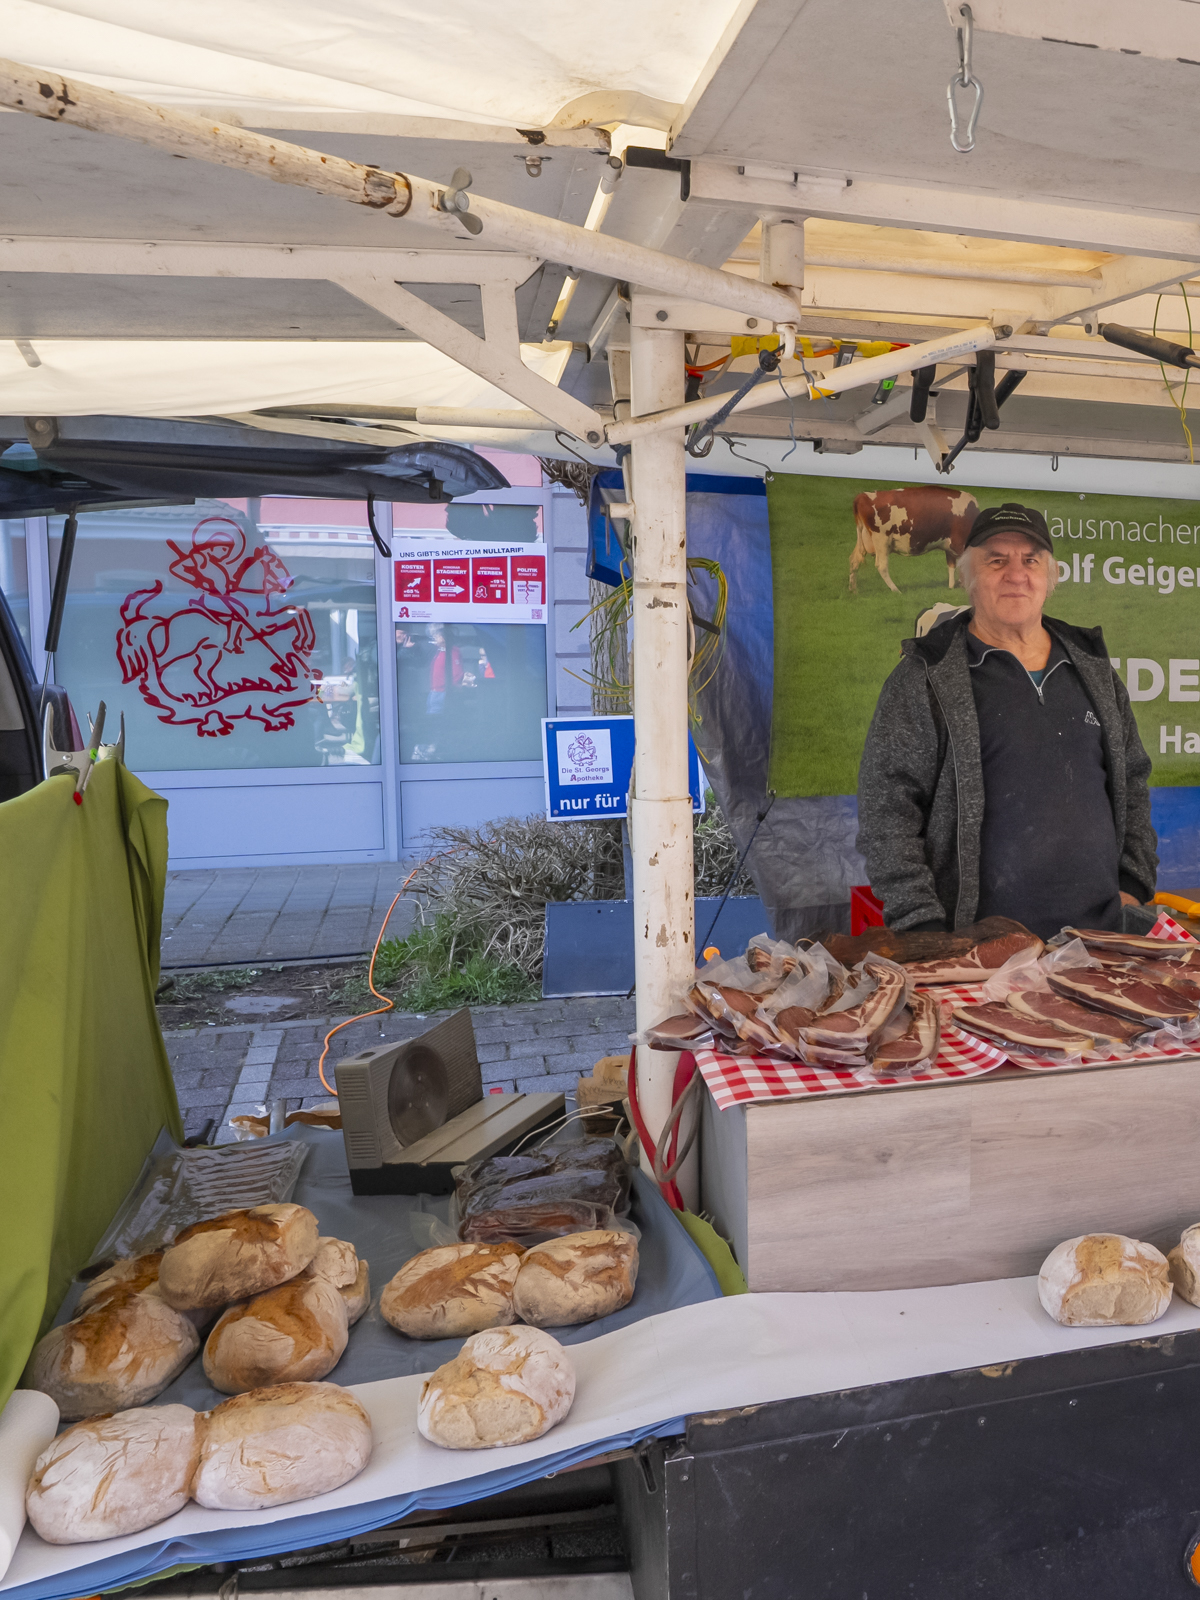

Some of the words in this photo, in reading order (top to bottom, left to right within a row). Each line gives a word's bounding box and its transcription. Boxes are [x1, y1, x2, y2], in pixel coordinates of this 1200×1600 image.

[417, 550, 440, 558] GIBT'S
[483, 547, 524, 555] NULLTARIF!
[1057, 552, 1095, 584] olf
[561, 766, 573, 774] Die
[585, 766, 610, 774] Georgs
[570, 774, 604, 782] Apotheke
[560, 797, 590, 810] nur
[595, 793, 620, 809] für
